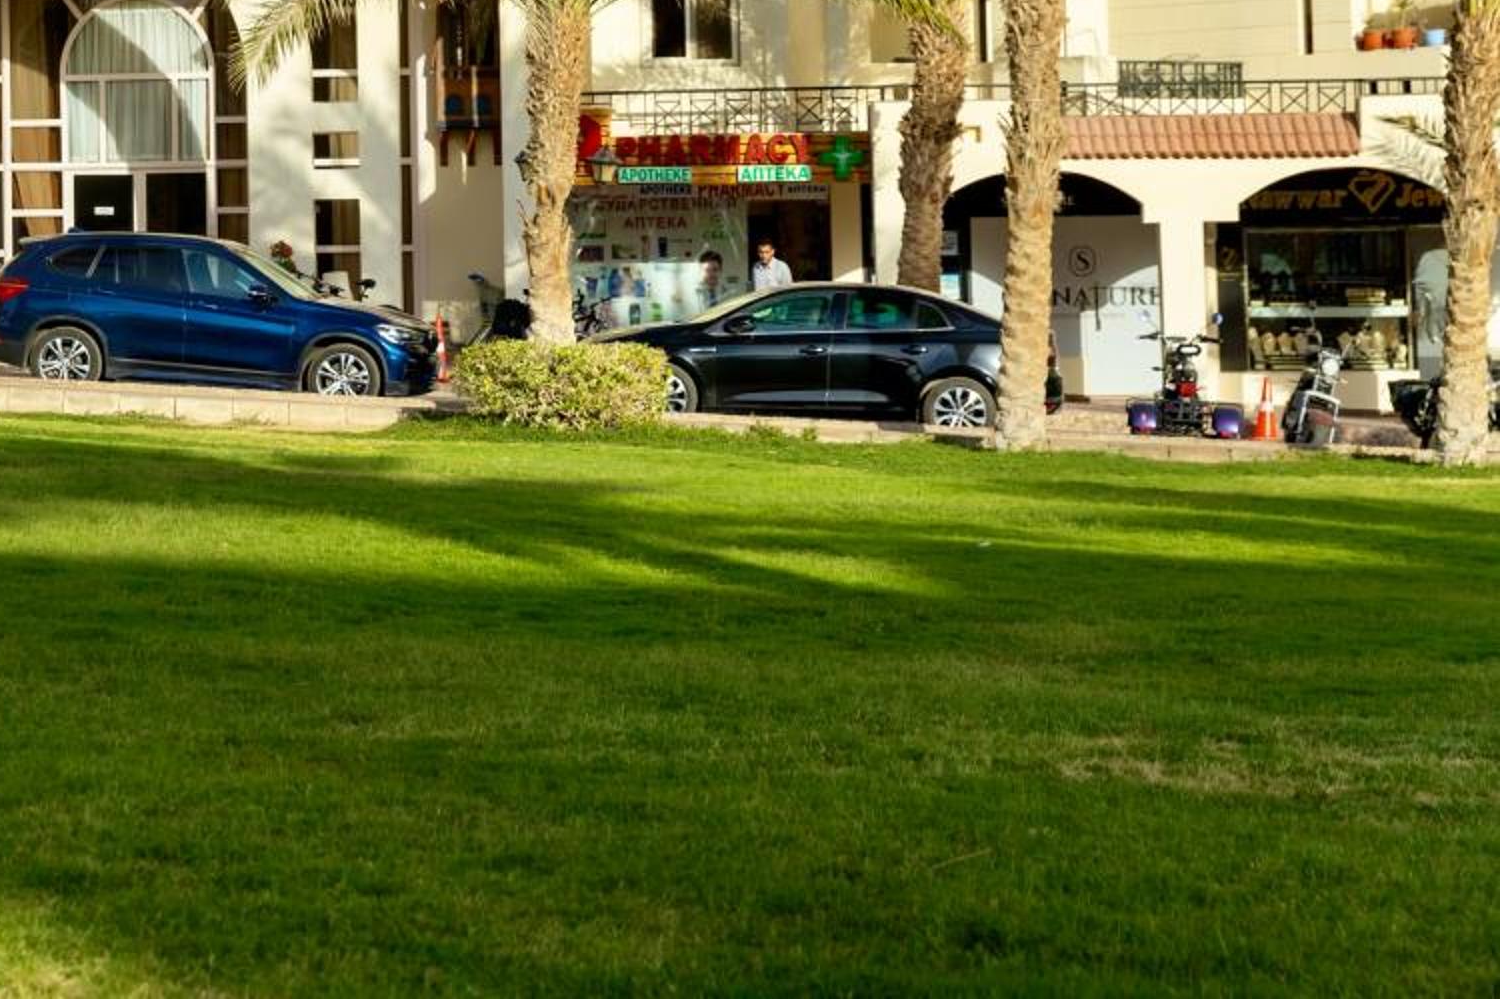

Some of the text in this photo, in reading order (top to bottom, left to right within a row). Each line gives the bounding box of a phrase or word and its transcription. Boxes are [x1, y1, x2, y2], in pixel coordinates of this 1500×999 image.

[617, 134, 810, 166] PHARMACY
[620, 167, 691, 183] APOTHEKE
[740, 166, 810, 182] АПТЕКА
[1396, 183, 1447, 209] Jew
[1052, 286, 1160, 306] NATURE
